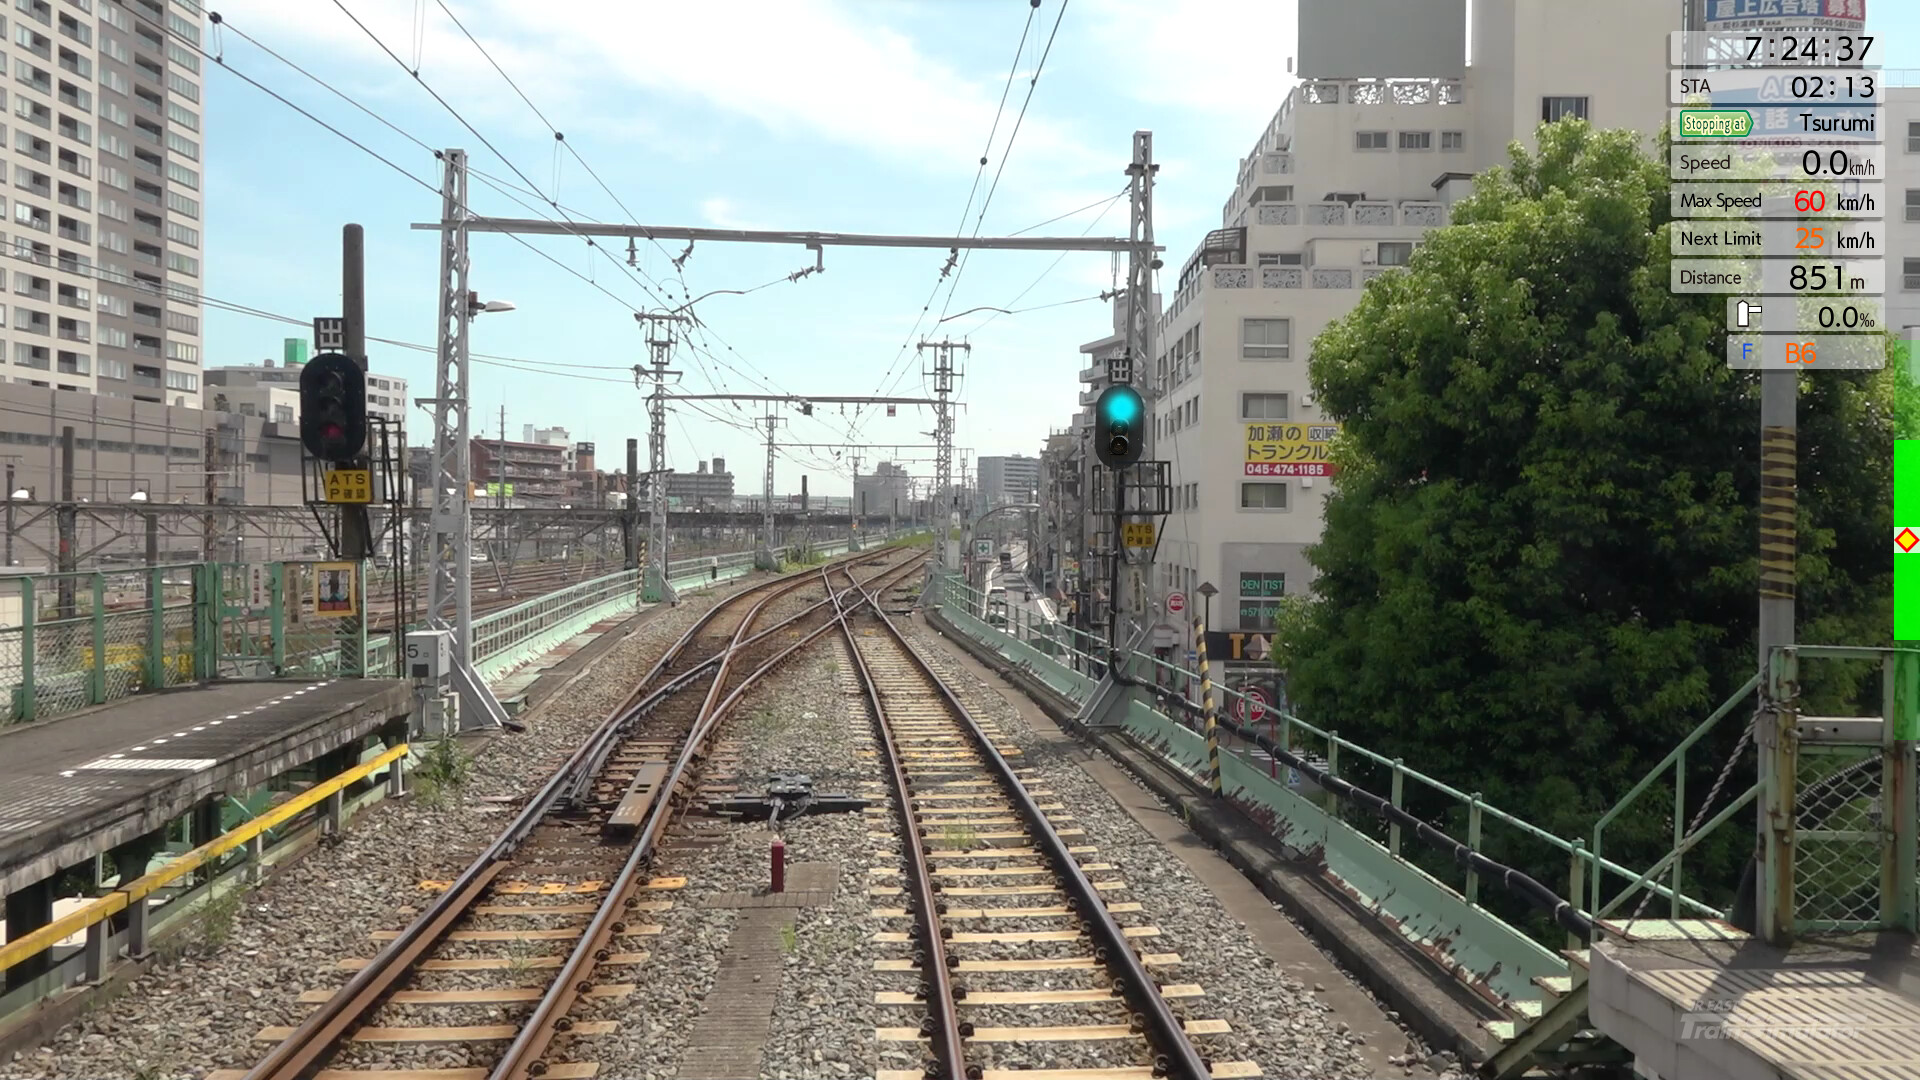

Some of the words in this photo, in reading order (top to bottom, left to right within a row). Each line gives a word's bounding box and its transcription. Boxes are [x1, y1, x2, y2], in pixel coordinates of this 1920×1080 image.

[319, 319, 344, 348] 出
[1111, 359, 1130, 382] 出
[1248, 425, 1301, 441] 加瀬の
[329, 473, 366, 485] ATS
[1127, 525, 1152, 534] ATS
[1241, 580, 1284, 590] DENTIST
[407, 644, 419, 659] 5
